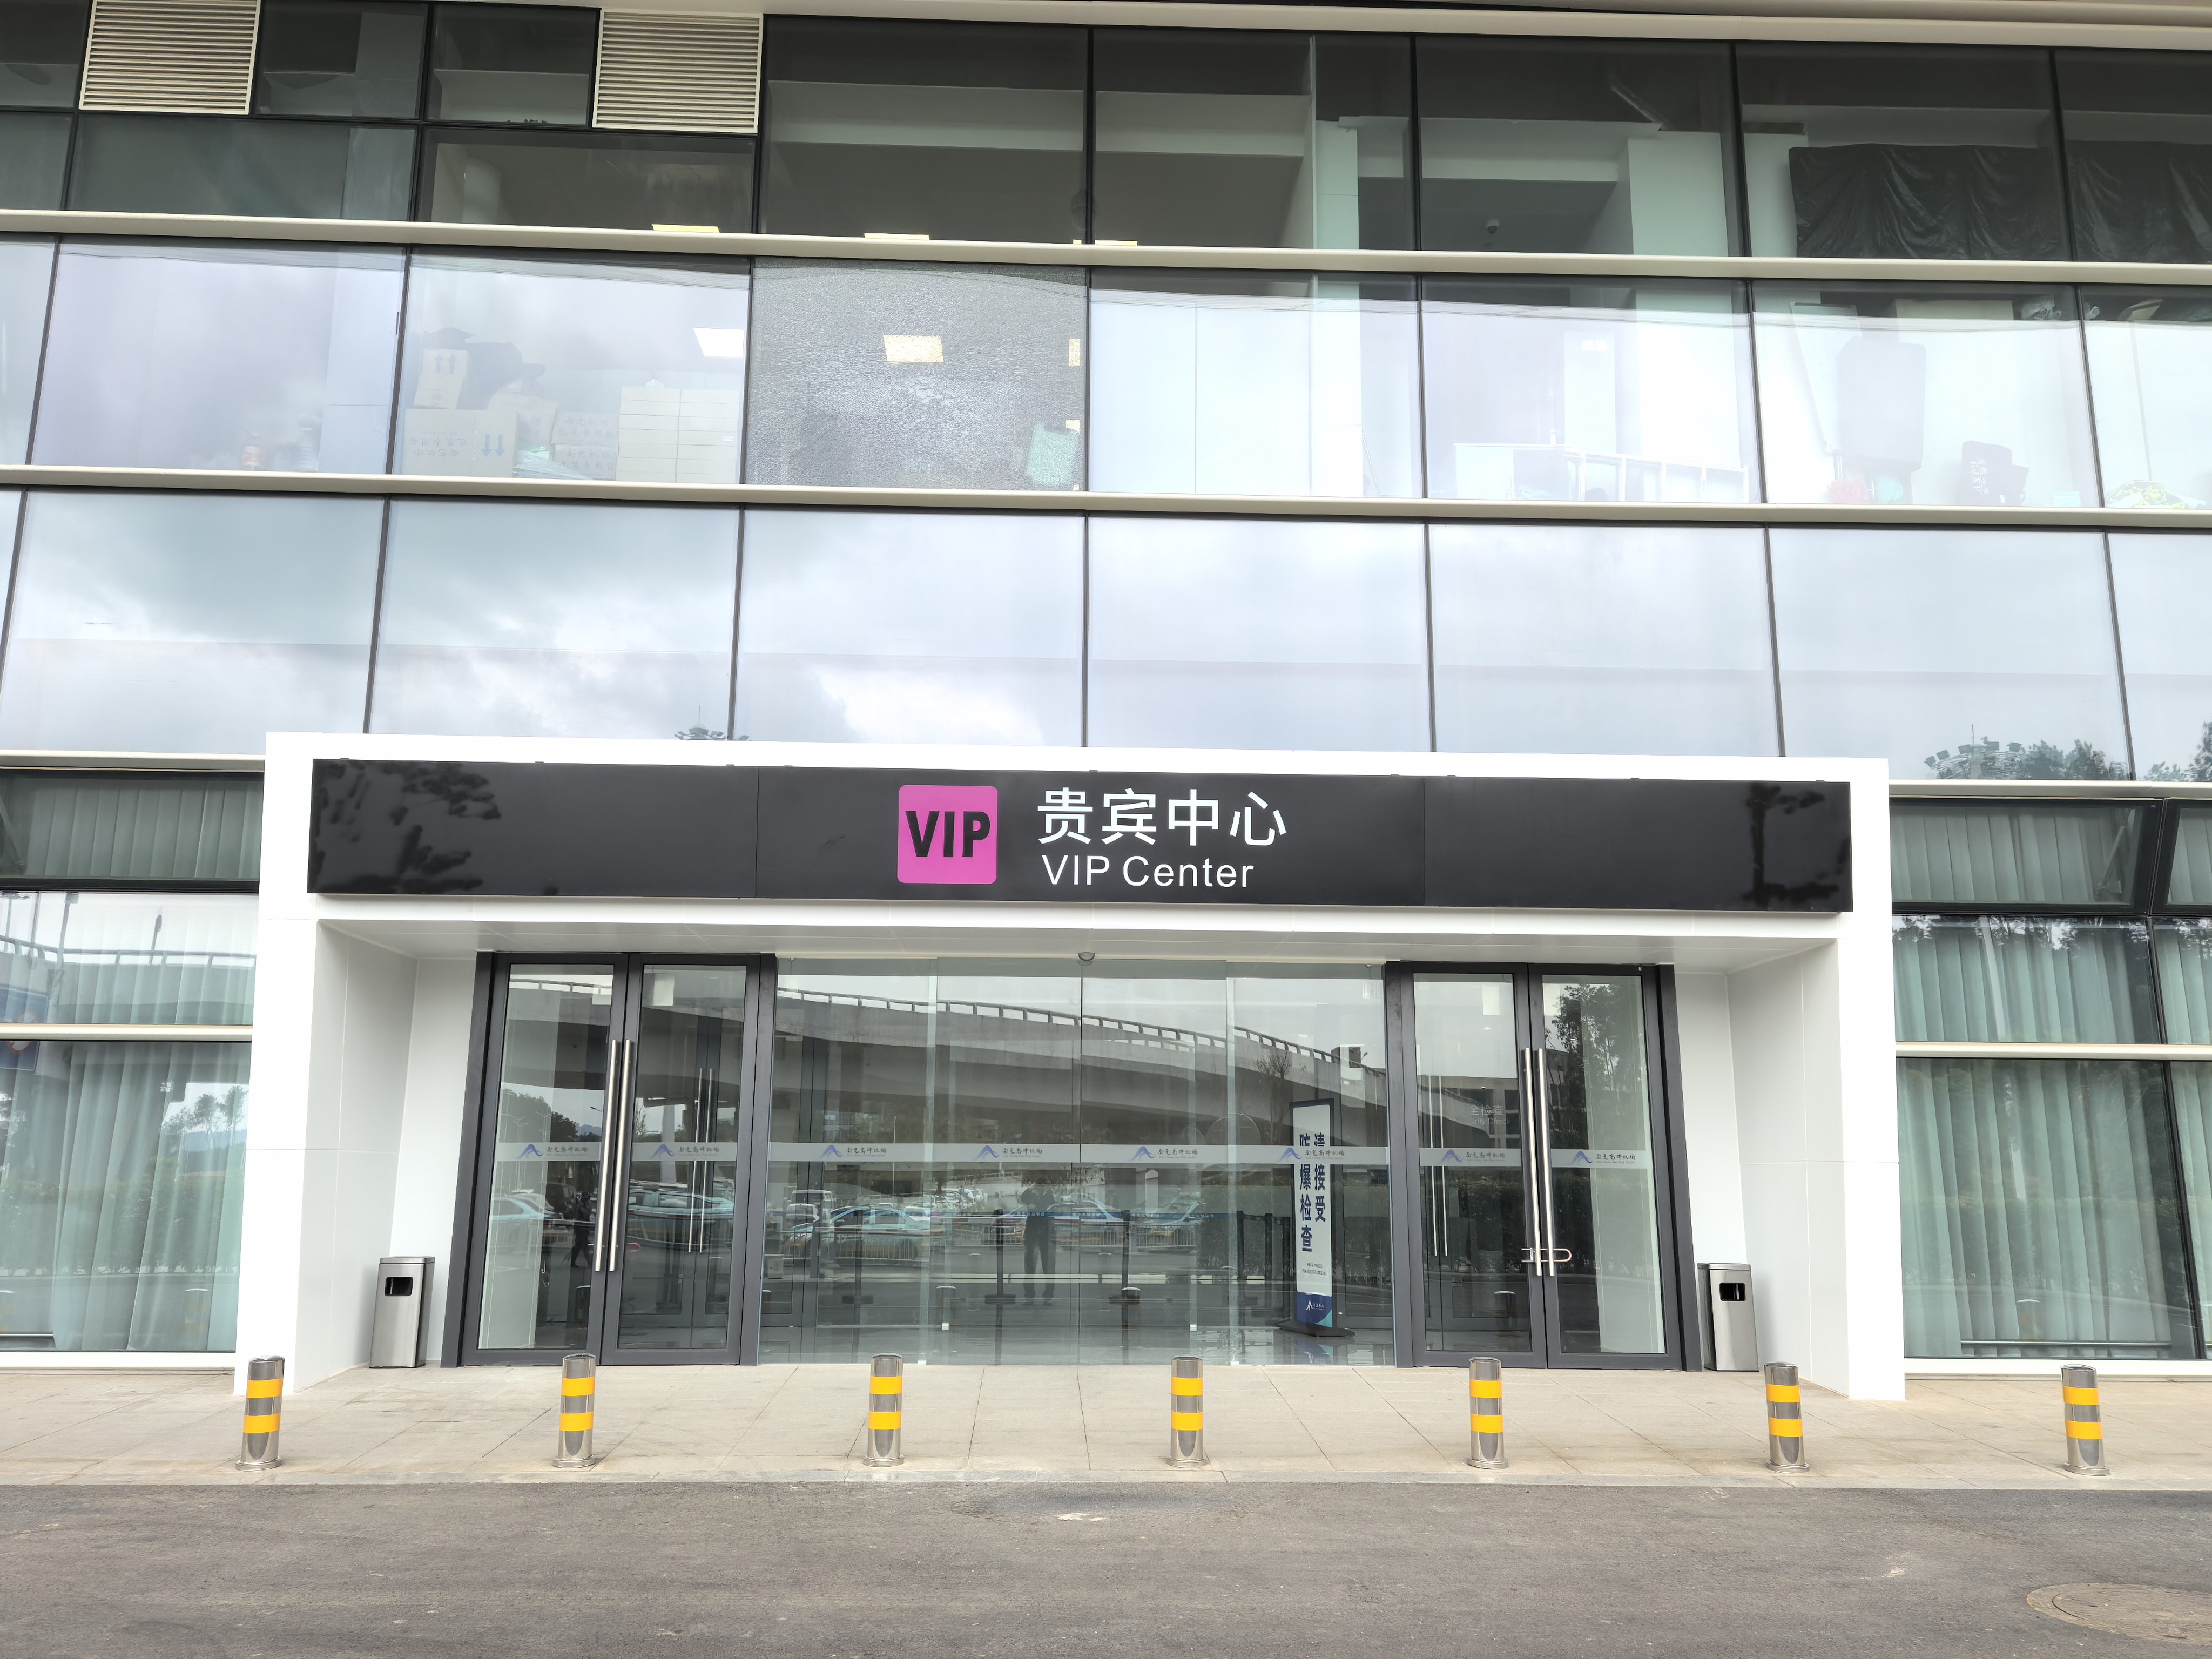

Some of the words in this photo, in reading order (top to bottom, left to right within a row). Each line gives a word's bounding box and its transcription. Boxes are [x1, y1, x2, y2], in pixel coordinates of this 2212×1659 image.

[905, 811, 990, 858] VIP
[1037, 787, 1287, 847] 贵宾中心
[1042, 855, 1111, 886] VIP
[1123, 855, 1255, 888] Center
